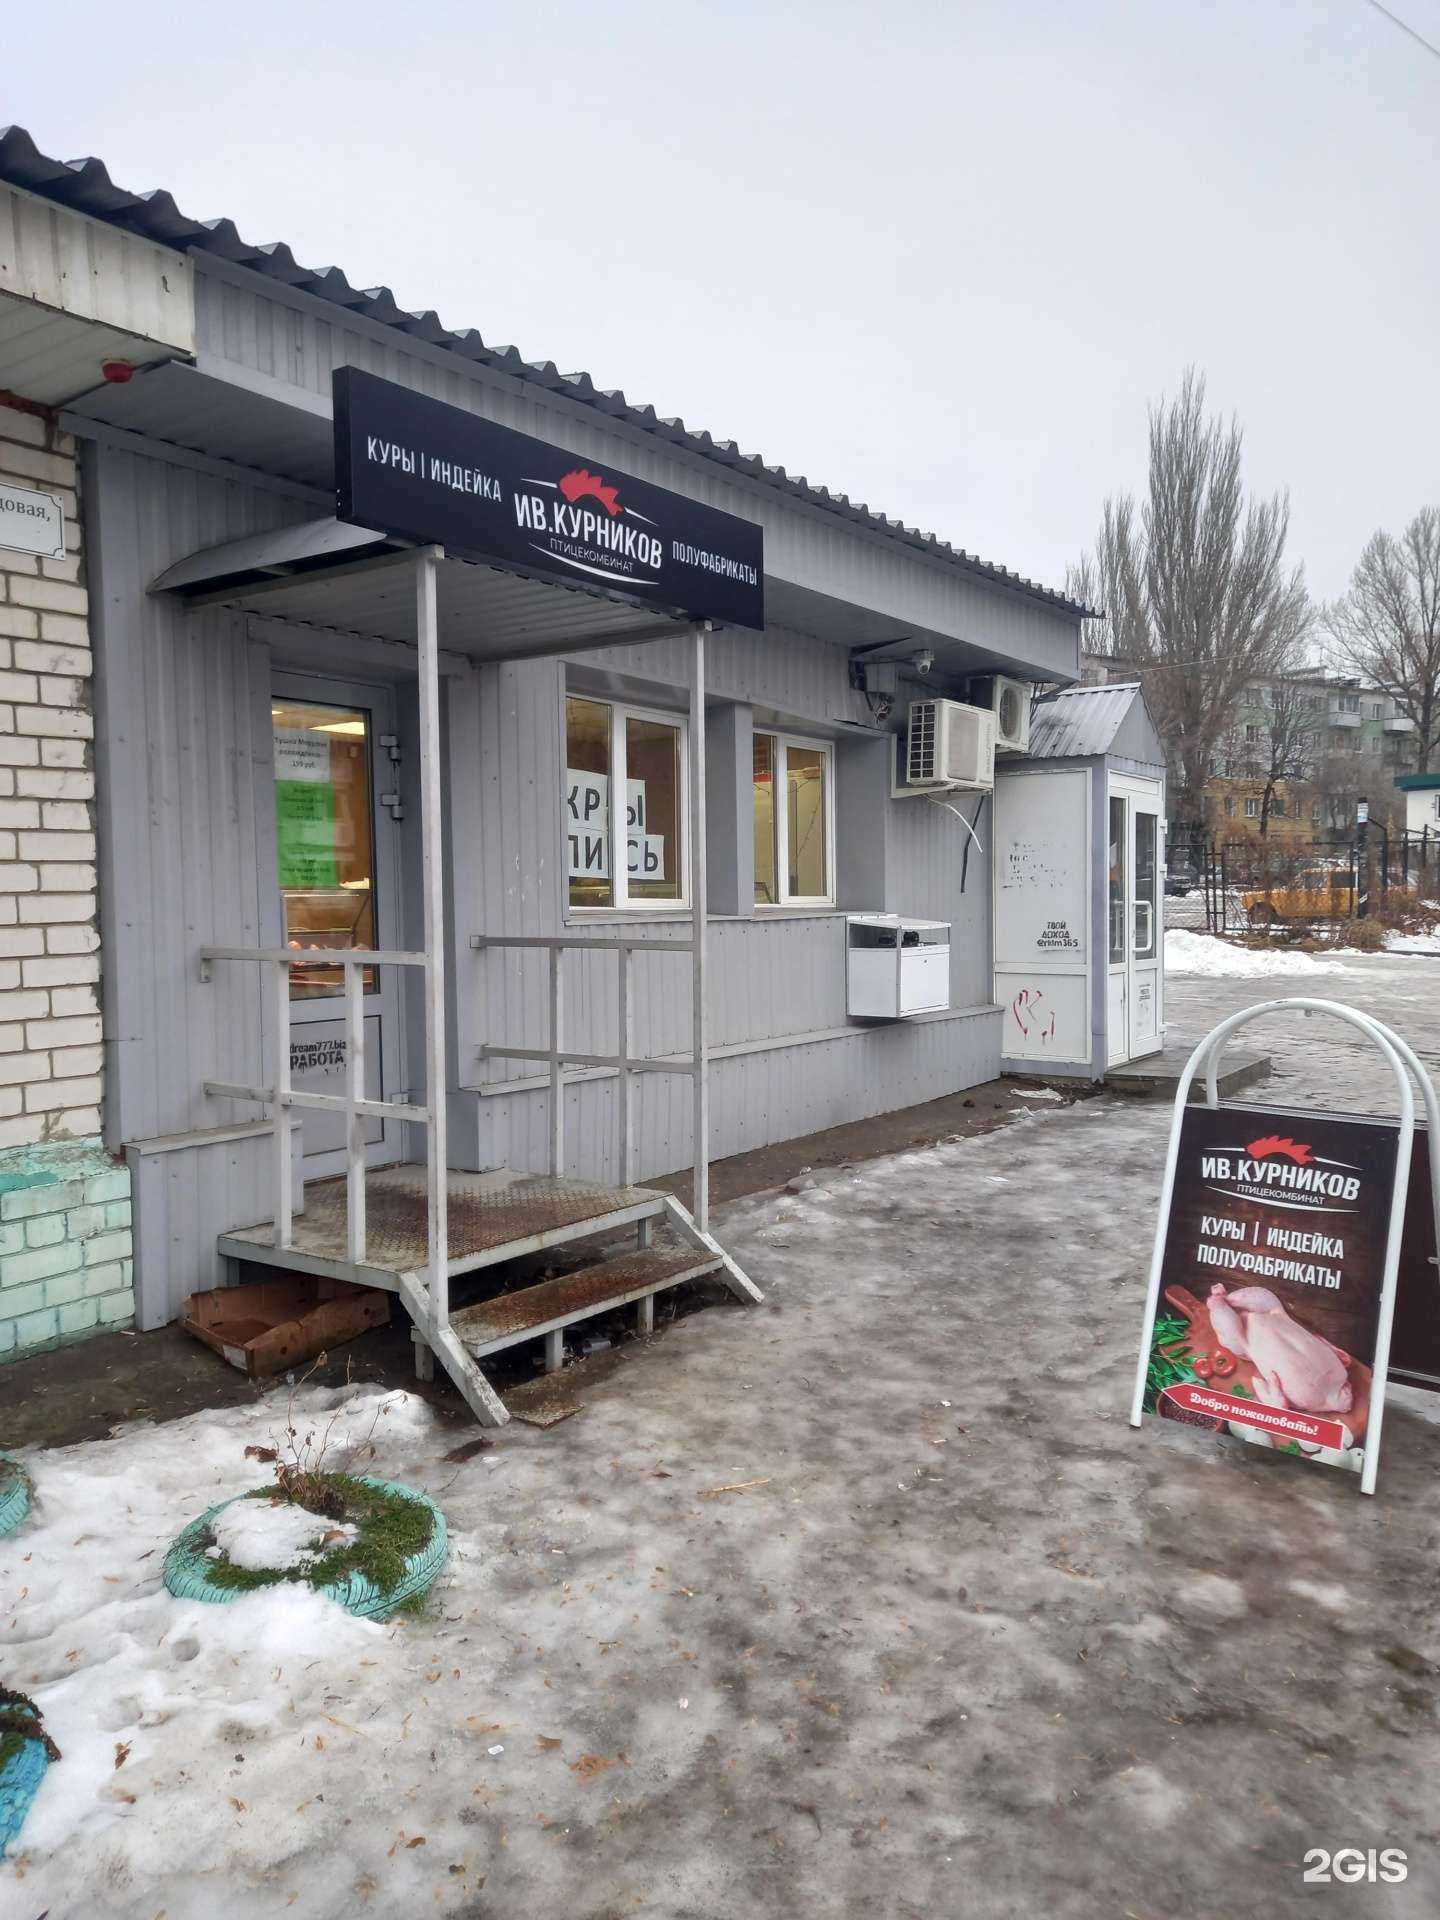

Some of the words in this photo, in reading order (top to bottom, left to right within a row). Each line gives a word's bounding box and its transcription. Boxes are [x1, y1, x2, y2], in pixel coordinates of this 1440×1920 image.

[367, 435, 415, 474] КУРЫ
[431, 457, 502, 502] ИНДЕЙКА
[514, 493, 663, 569] ИВ.КУРНИКОВ
[550, 537, 634, 573] ПТИЦЕКОМБИНАТ
[672, 540, 758, 586] ПОЛУФАБРИКАТЫ
[289, 1050, 345, 1071] РАБОТА
[1201, 1156, 1362, 1201] ИВ.КУРНИКОВ
[1236, 1183, 1326, 1206] ПТИЦЕКОМБИНАТ
[1200, 1215, 1247, 1242] КУРЫ
[1266, 1226, 1345, 1260] ИНДЕЙКА
[1197, 1243, 1342, 1290] ПОЛУФАБРИКАТЫ
[1189, 1392, 1230, 1415] Добро
[1231, 1405, 1319, 1437] пожаловать!
